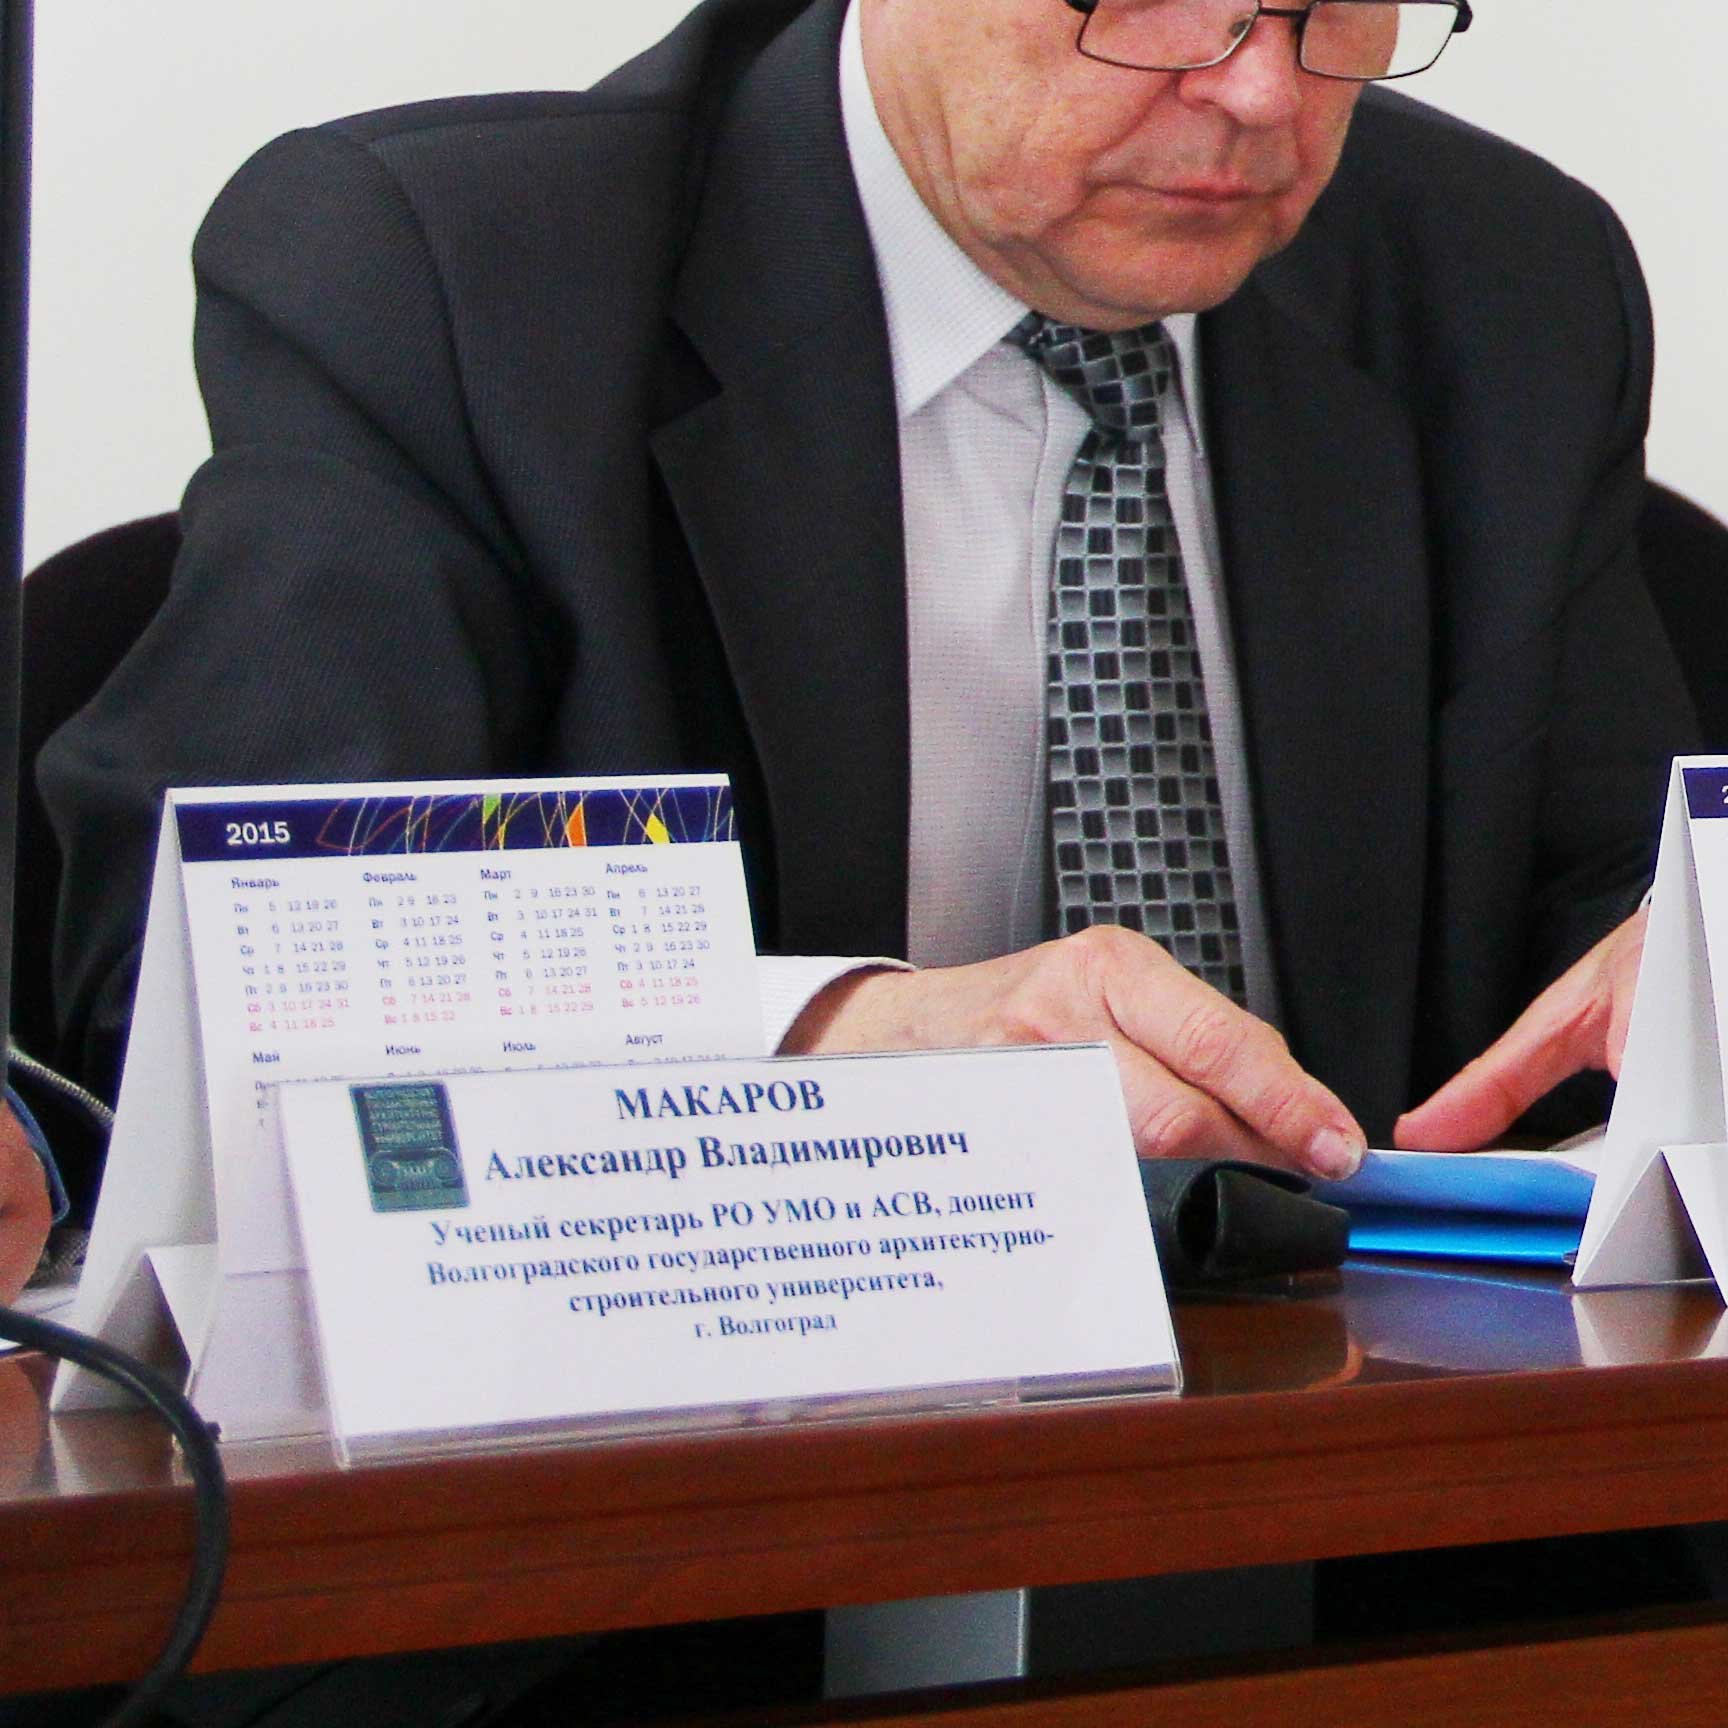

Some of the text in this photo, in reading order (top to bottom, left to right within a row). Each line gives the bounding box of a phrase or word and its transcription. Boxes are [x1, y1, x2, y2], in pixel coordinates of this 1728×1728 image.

[226, 821, 291, 846] 2015
[480, 869, 511, 880] Март
[606, 863, 648, 875] Апрель
[231, 877, 279, 890] Январь
[503, 1041, 536, 1052] Июль
[625, 1033, 663, 1046] Август
[252, 1051, 280, 1062] Май
[385, 1045, 421, 1056] Июнь
[615, 1080, 825, 1120] МАКАРОВ
[485, 1131, 969, 1180] Александр Владимирович
[431, 1191, 1037, 1246] Ученый секретарь РО УМО и АСВ, доцент
[426, 1228, 1055, 1285] Волгоградского государственного архитектурно-
[569, 1270, 944, 1316] строительного университета,
[694, 1314, 837, 1338] г. Волгоград
